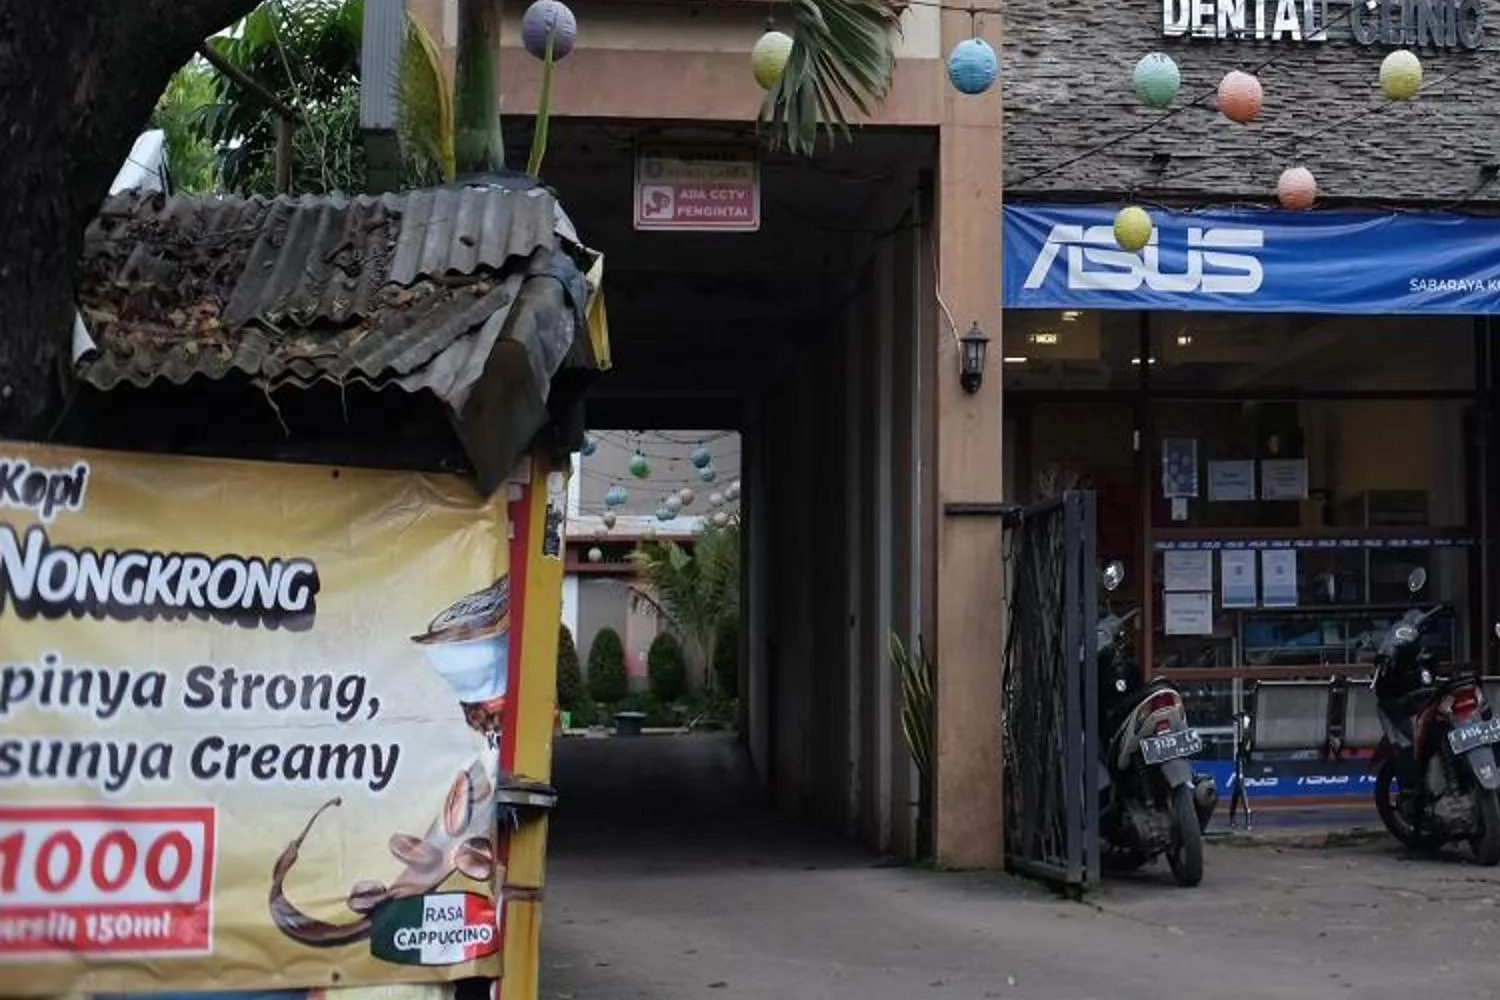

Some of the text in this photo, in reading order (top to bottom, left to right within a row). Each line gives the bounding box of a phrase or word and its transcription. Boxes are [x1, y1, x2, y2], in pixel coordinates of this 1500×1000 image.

[709, 189, 746, 199] CCTV
[677, 206, 748, 217] PENGINTAI
[1024, 224, 1263, 293] ASUS
[1409, 278, 1485, 293] SABARAYA
[0, 463, 87, 517] Kopi
[184, 665, 381, 722] Strong,
[190, 736, 400, 792] Creamy
[425, 906, 463, 922] RASA
[86, 911, 171, 943] 150ml
[396, 927, 491, 946] CAPPUCCINO
